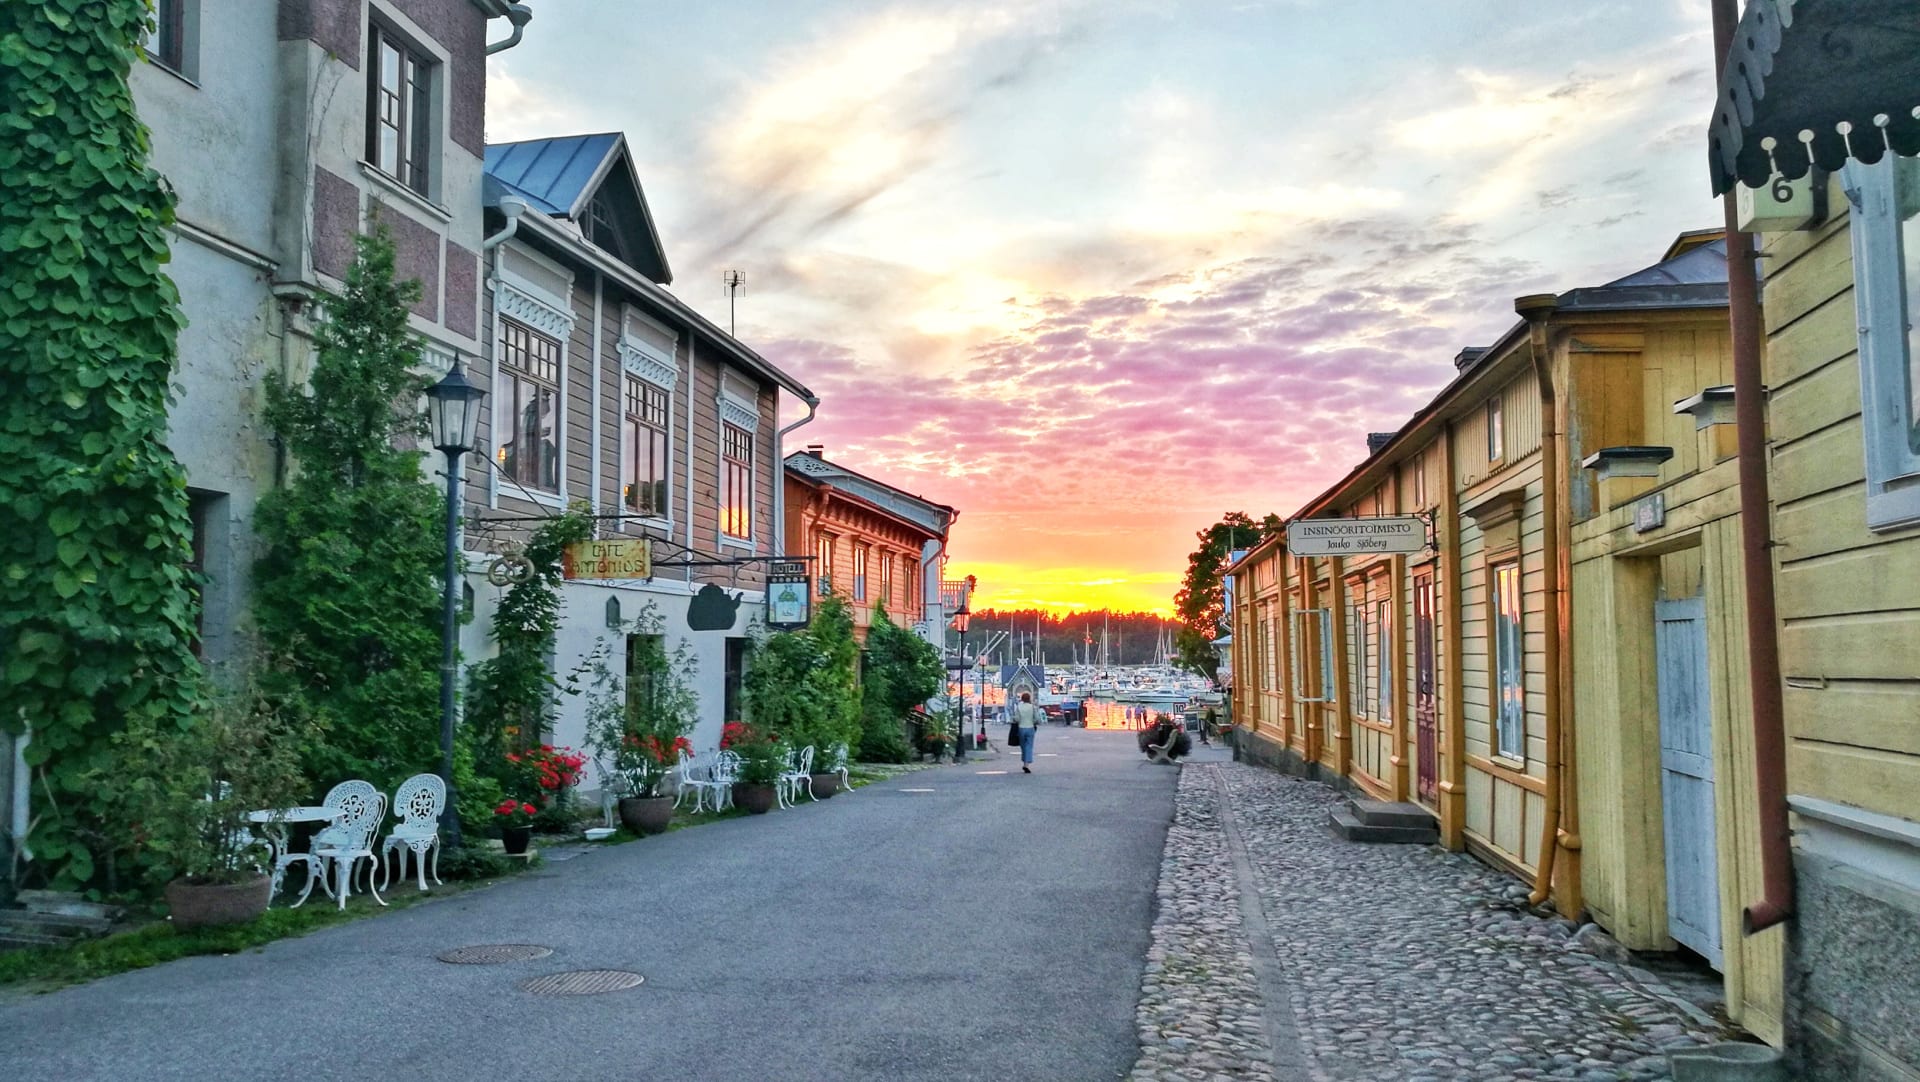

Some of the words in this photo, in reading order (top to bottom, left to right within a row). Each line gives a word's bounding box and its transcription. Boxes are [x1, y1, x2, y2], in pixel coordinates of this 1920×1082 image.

[1772, 176, 1793, 203] 6
[1303, 523, 1411, 536] INSINÖÖRITOIMISTO
[1327, 538, 1351, 549] Jouko
[1356, 537, 1387, 551] Sjöberg
[572, 559, 644, 573] ANTONIUS
[1175, 704, 1184, 713] 10
